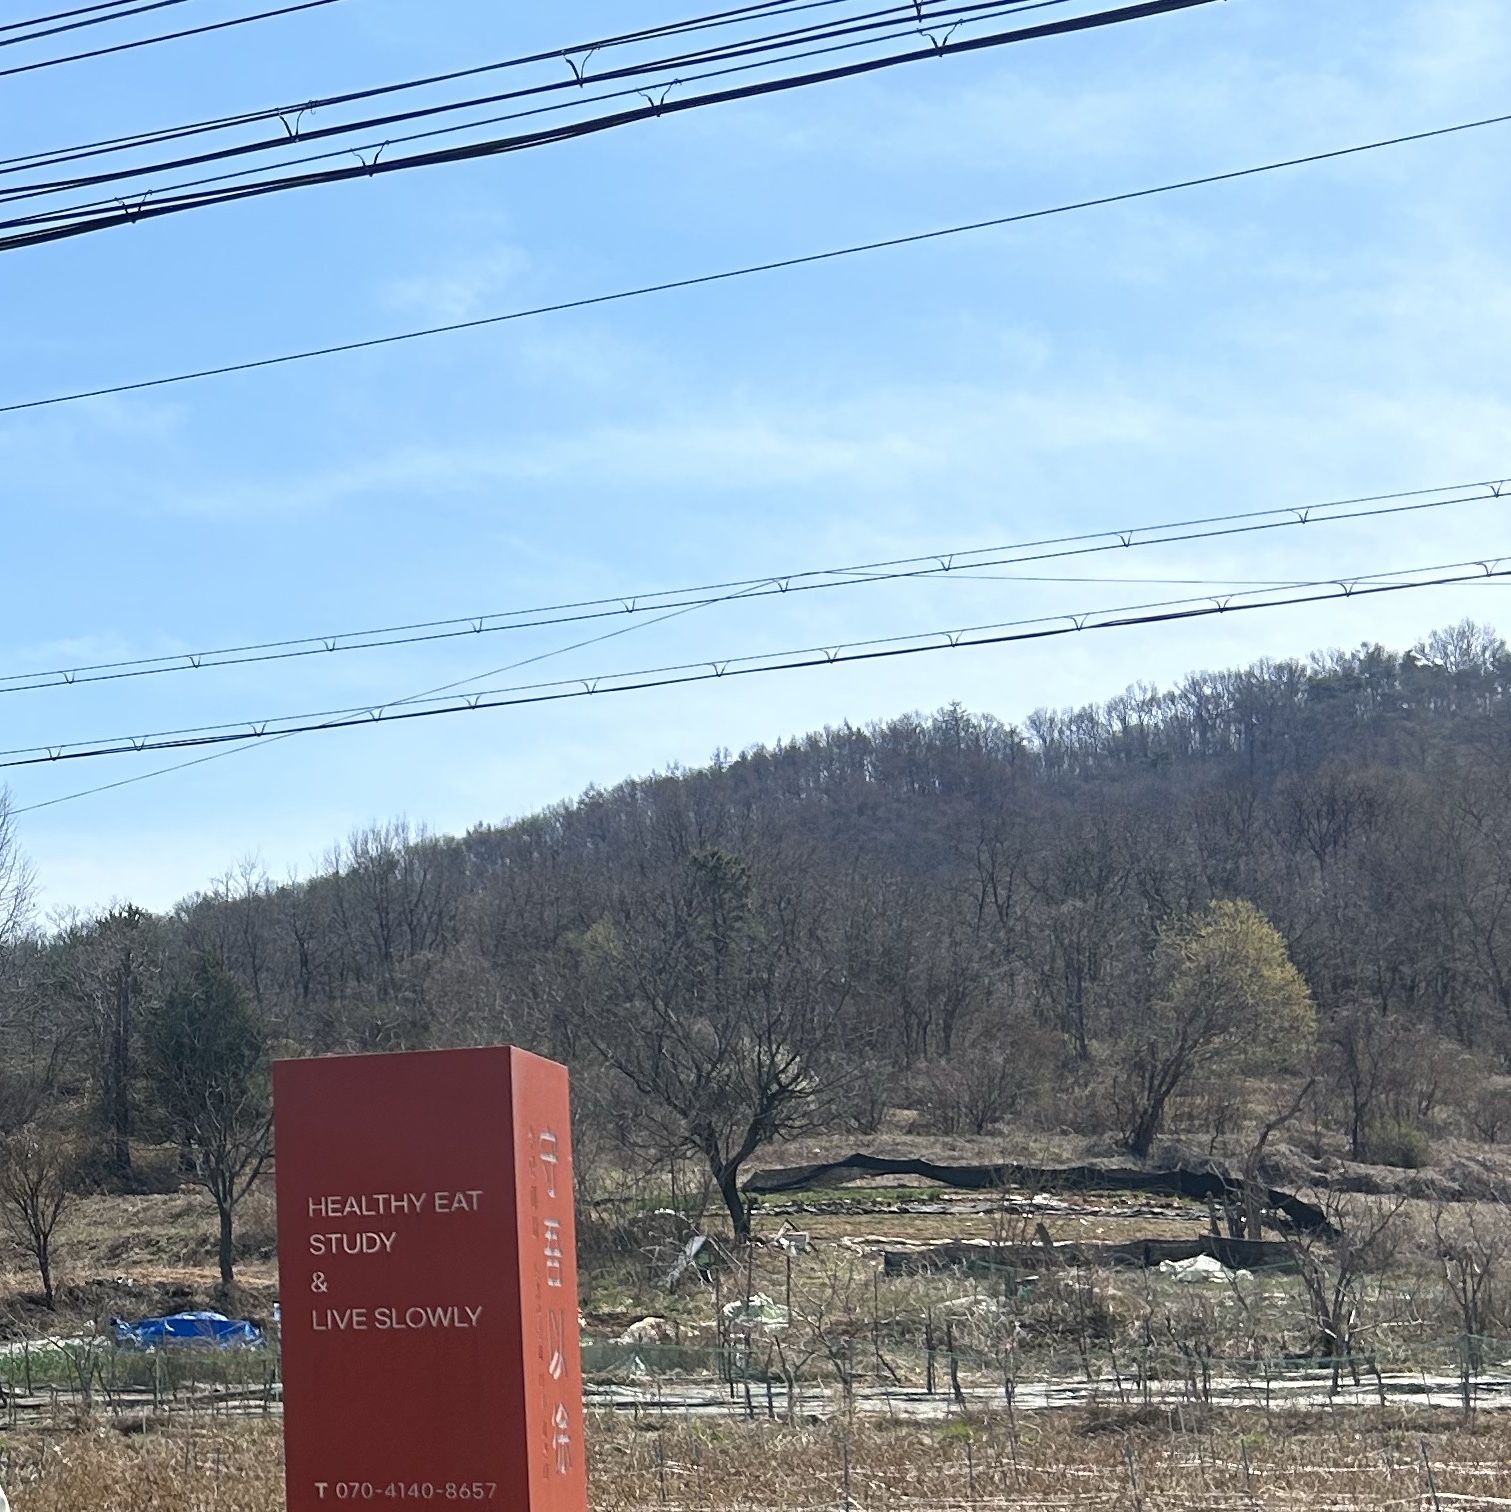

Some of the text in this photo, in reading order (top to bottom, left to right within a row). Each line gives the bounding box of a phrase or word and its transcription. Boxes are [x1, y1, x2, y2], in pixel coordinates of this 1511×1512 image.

[308, 1190, 484, 1218] HEALTHY EAT
[309, 1231, 397, 1255] STUDY
[310, 1271, 328, 1293] &
[312, 1305, 483, 1331] LIVE SLOWLY
[314, 1481, 498, 1500] T 070-4140-8657
